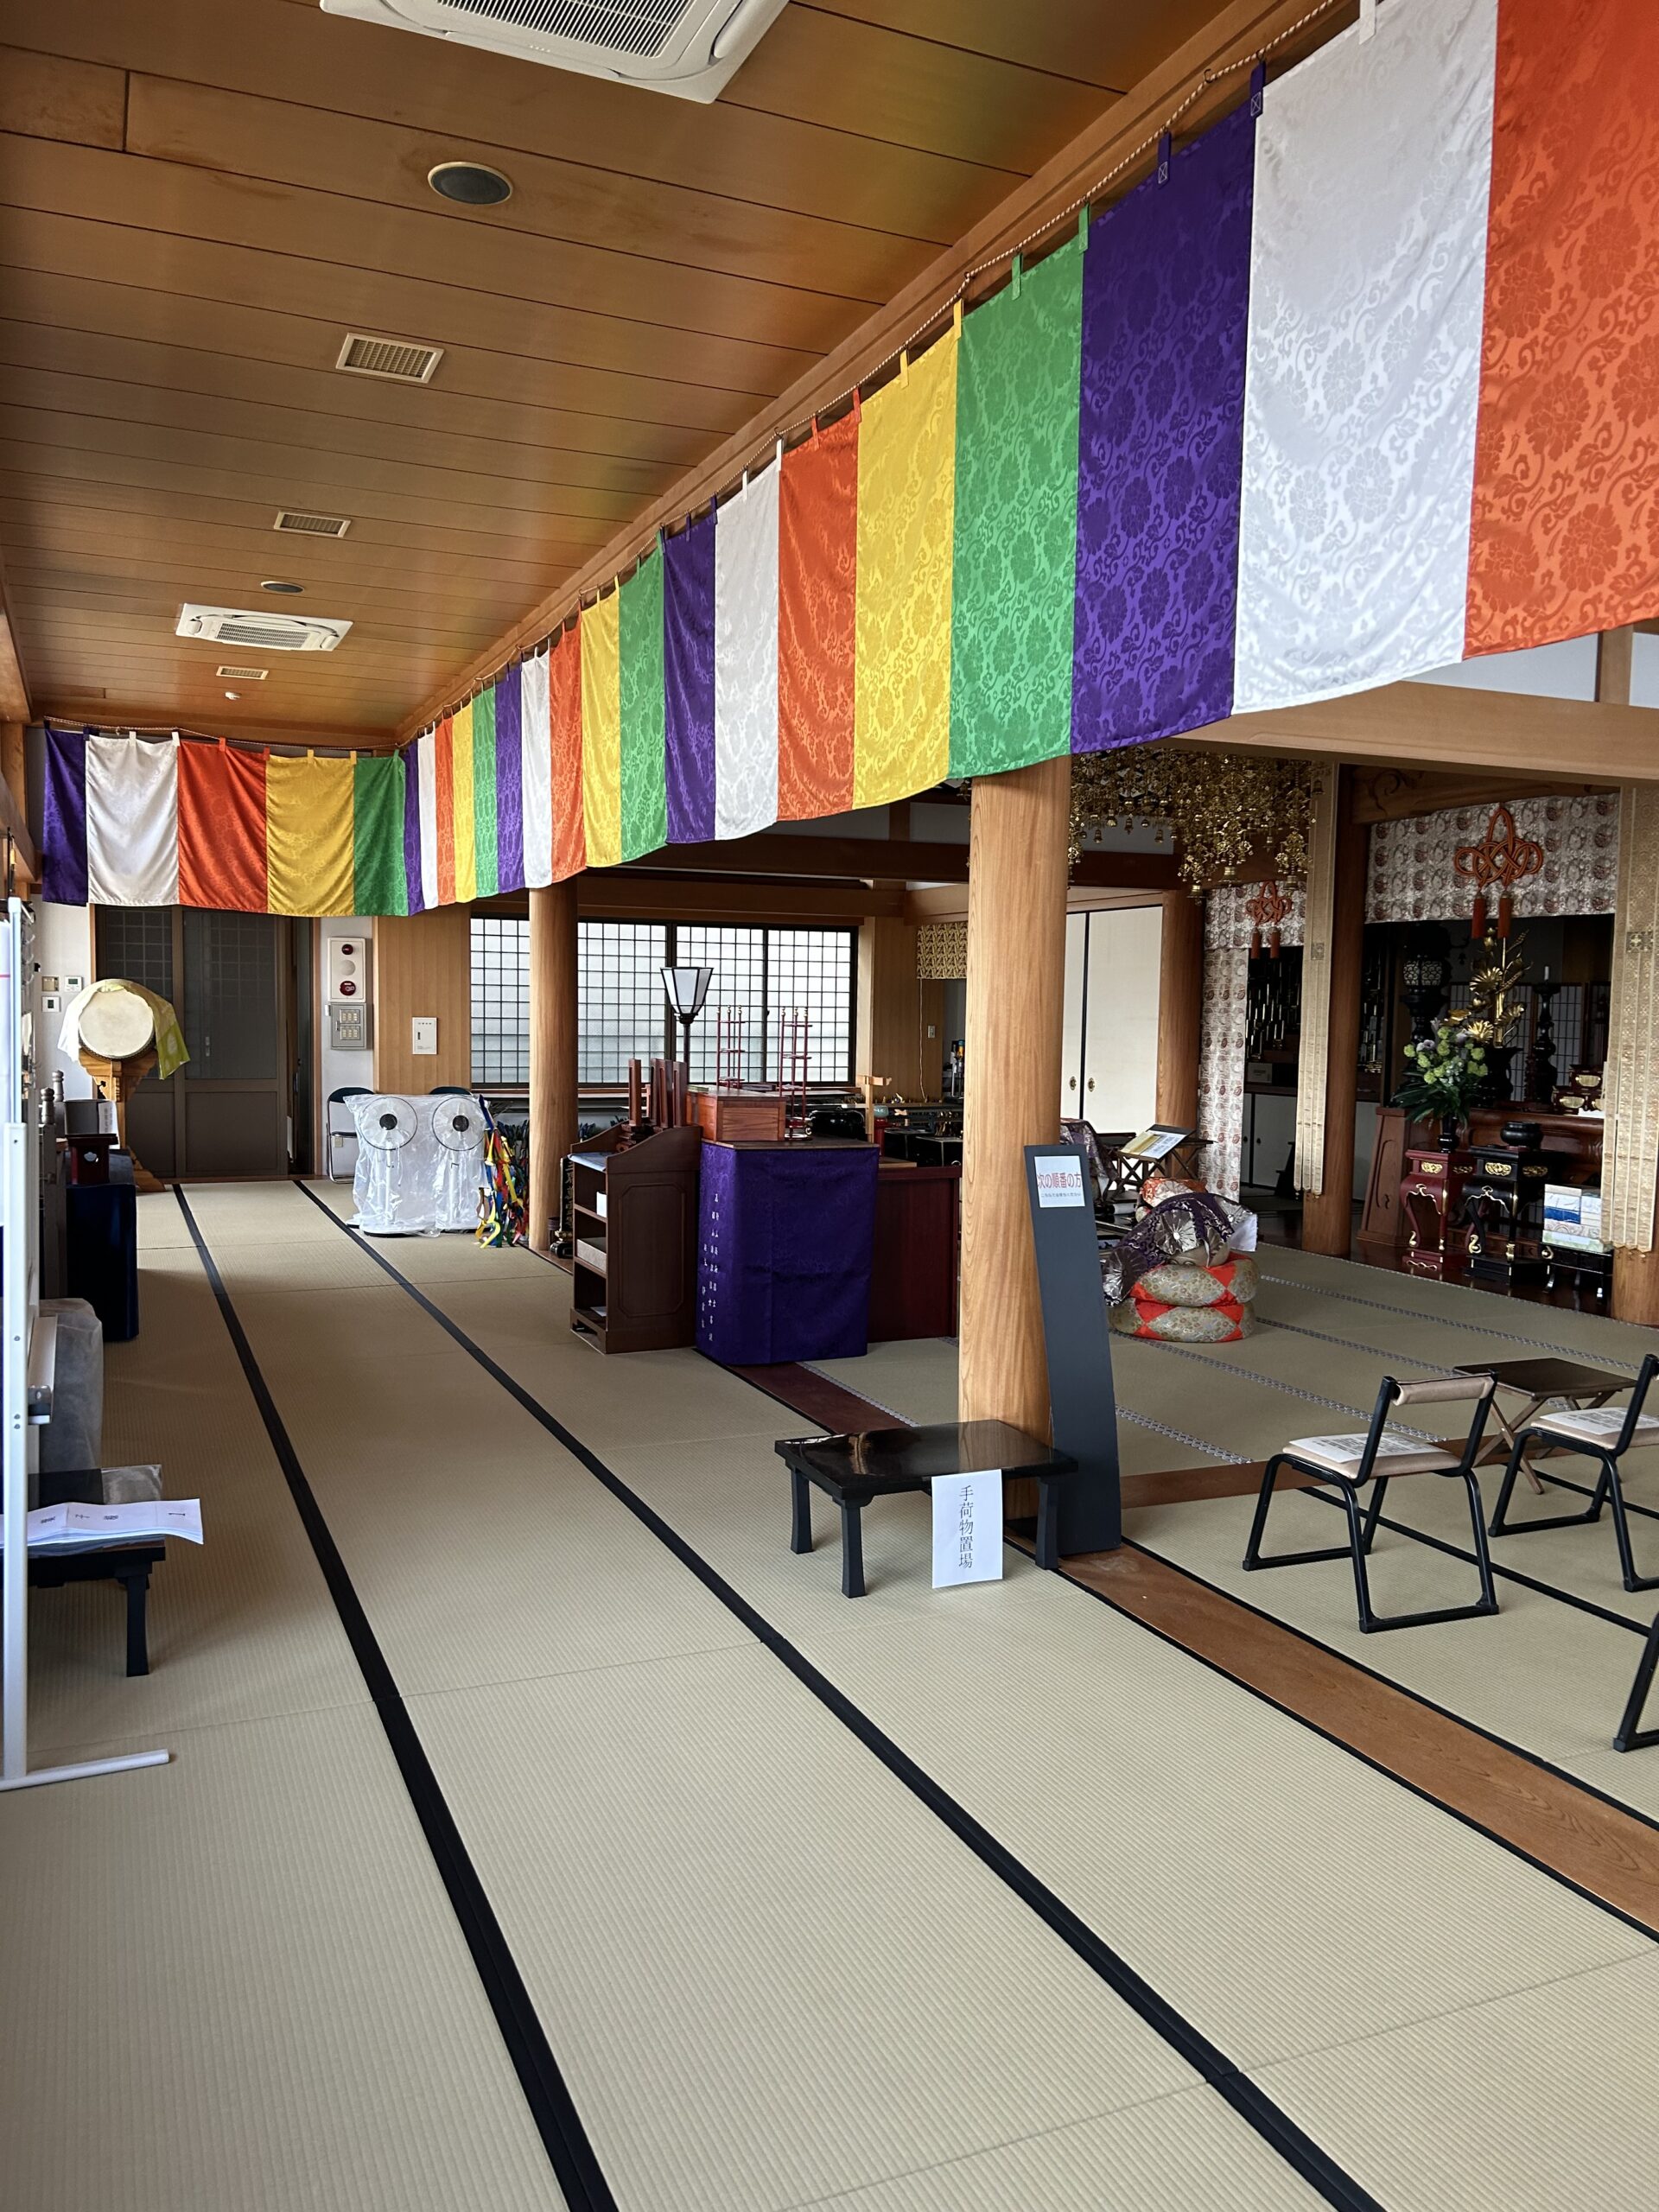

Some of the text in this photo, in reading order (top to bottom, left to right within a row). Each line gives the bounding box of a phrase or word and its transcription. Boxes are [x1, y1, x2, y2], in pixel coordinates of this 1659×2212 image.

[1037, 1173, 1081, 1189] 次の順番の方
[959, 1484, 974, 1568] 手荷物置場
